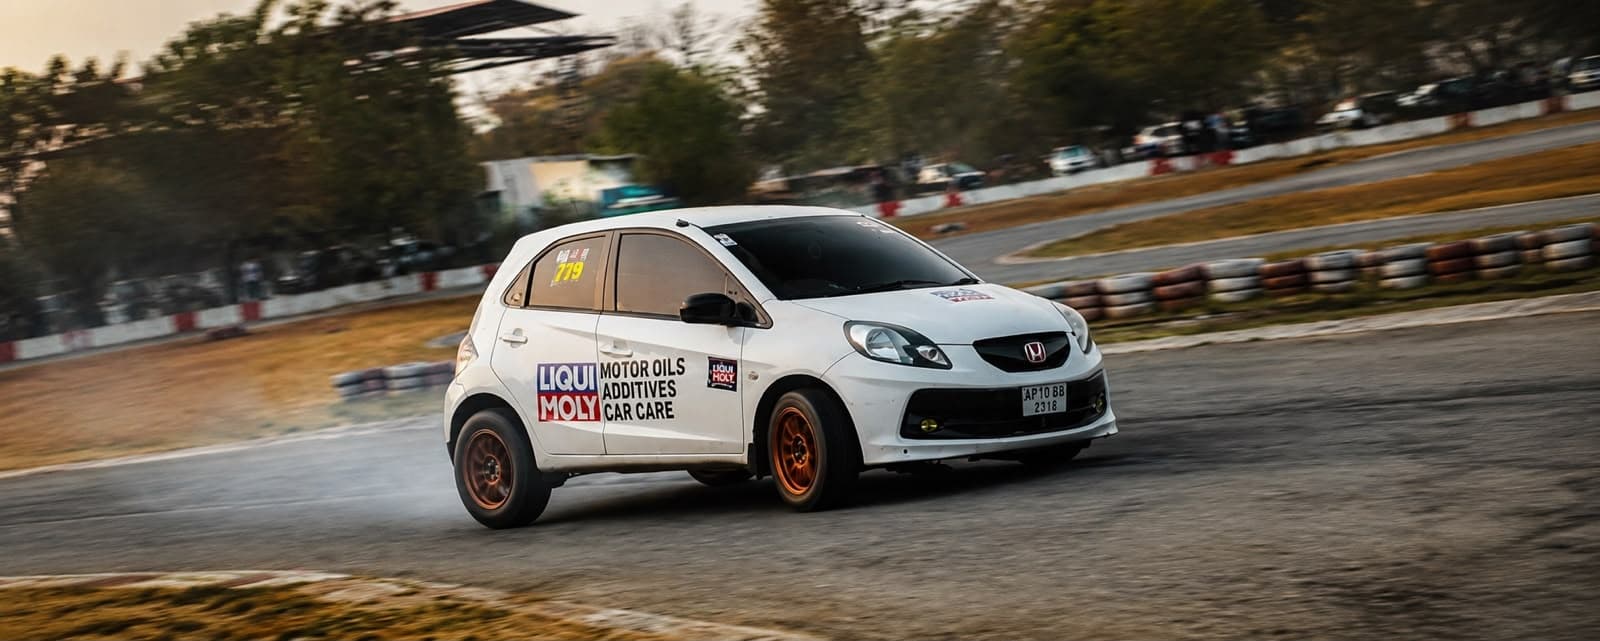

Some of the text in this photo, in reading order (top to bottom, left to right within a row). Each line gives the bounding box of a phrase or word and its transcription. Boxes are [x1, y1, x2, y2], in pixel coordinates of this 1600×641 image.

[554, 261, 584, 282] 779
[539, 365, 595, 392] LIQUI
[600, 357, 685, 379] MOTOR OILS
[712, 364, 734, 374] LIQUI
[602, 379, 677, 400] ADDITIVES
[540, 394, 598, 420] MOLY
[604, 401, 675, 421] CAR CARE
